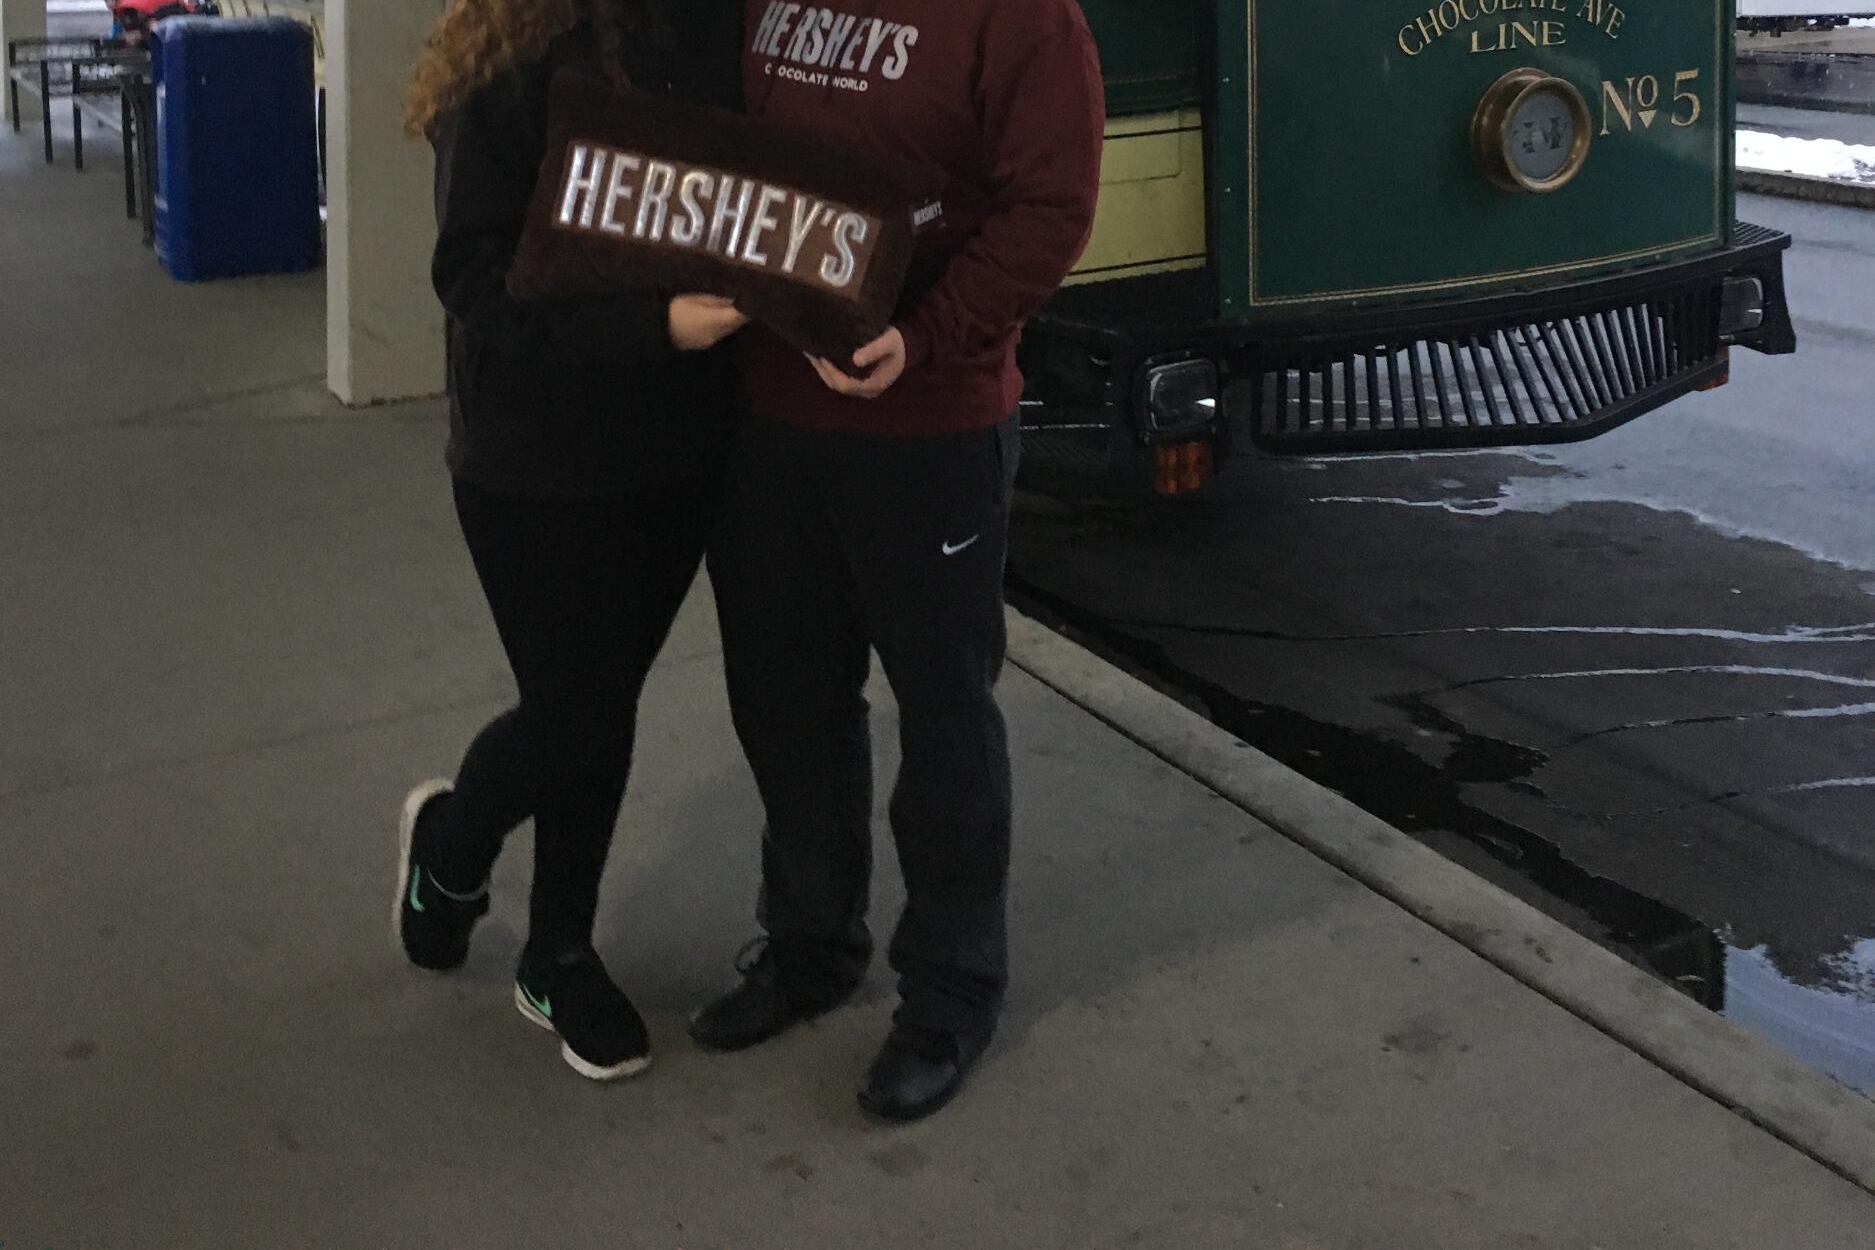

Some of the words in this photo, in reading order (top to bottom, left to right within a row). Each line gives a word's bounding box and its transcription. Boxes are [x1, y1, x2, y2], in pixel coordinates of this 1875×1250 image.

[751, 0, 919, 80] HERSHEY'S
[1470, 20, 1567, 54] LINE
[764, 62, 829, 87] COCOLATE
[832, 76, 868, 92] WORLD
[1670, 68, 1701, 127] 5
[559, 145, 868, 288] HERSHEY'S
